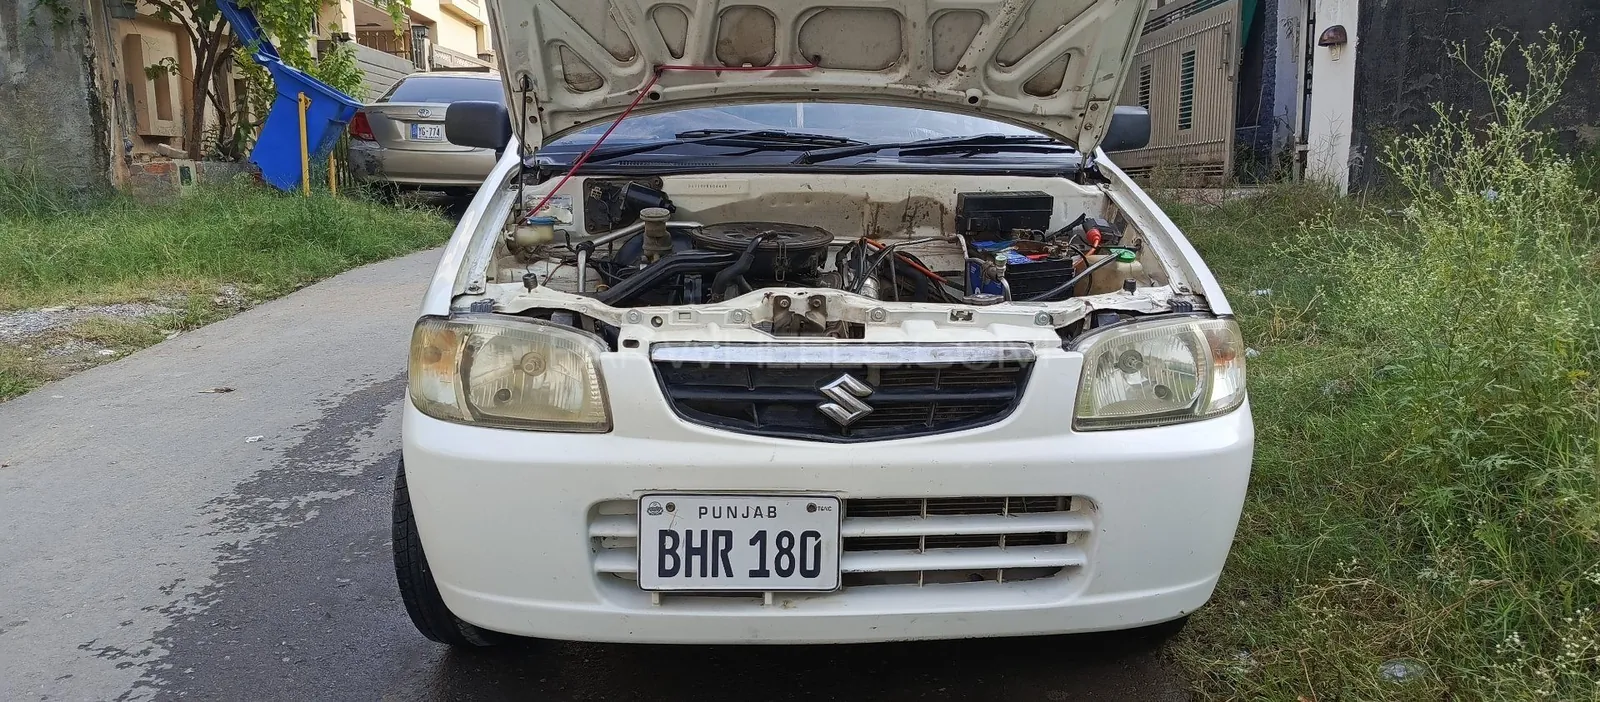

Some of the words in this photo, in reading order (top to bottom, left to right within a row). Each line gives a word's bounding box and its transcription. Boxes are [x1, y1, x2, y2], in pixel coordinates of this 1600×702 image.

[698, 505, 778, 519] PUNJAB
[658, 529, 734, 578] BHR
[748, 529, 822, 579] 180
